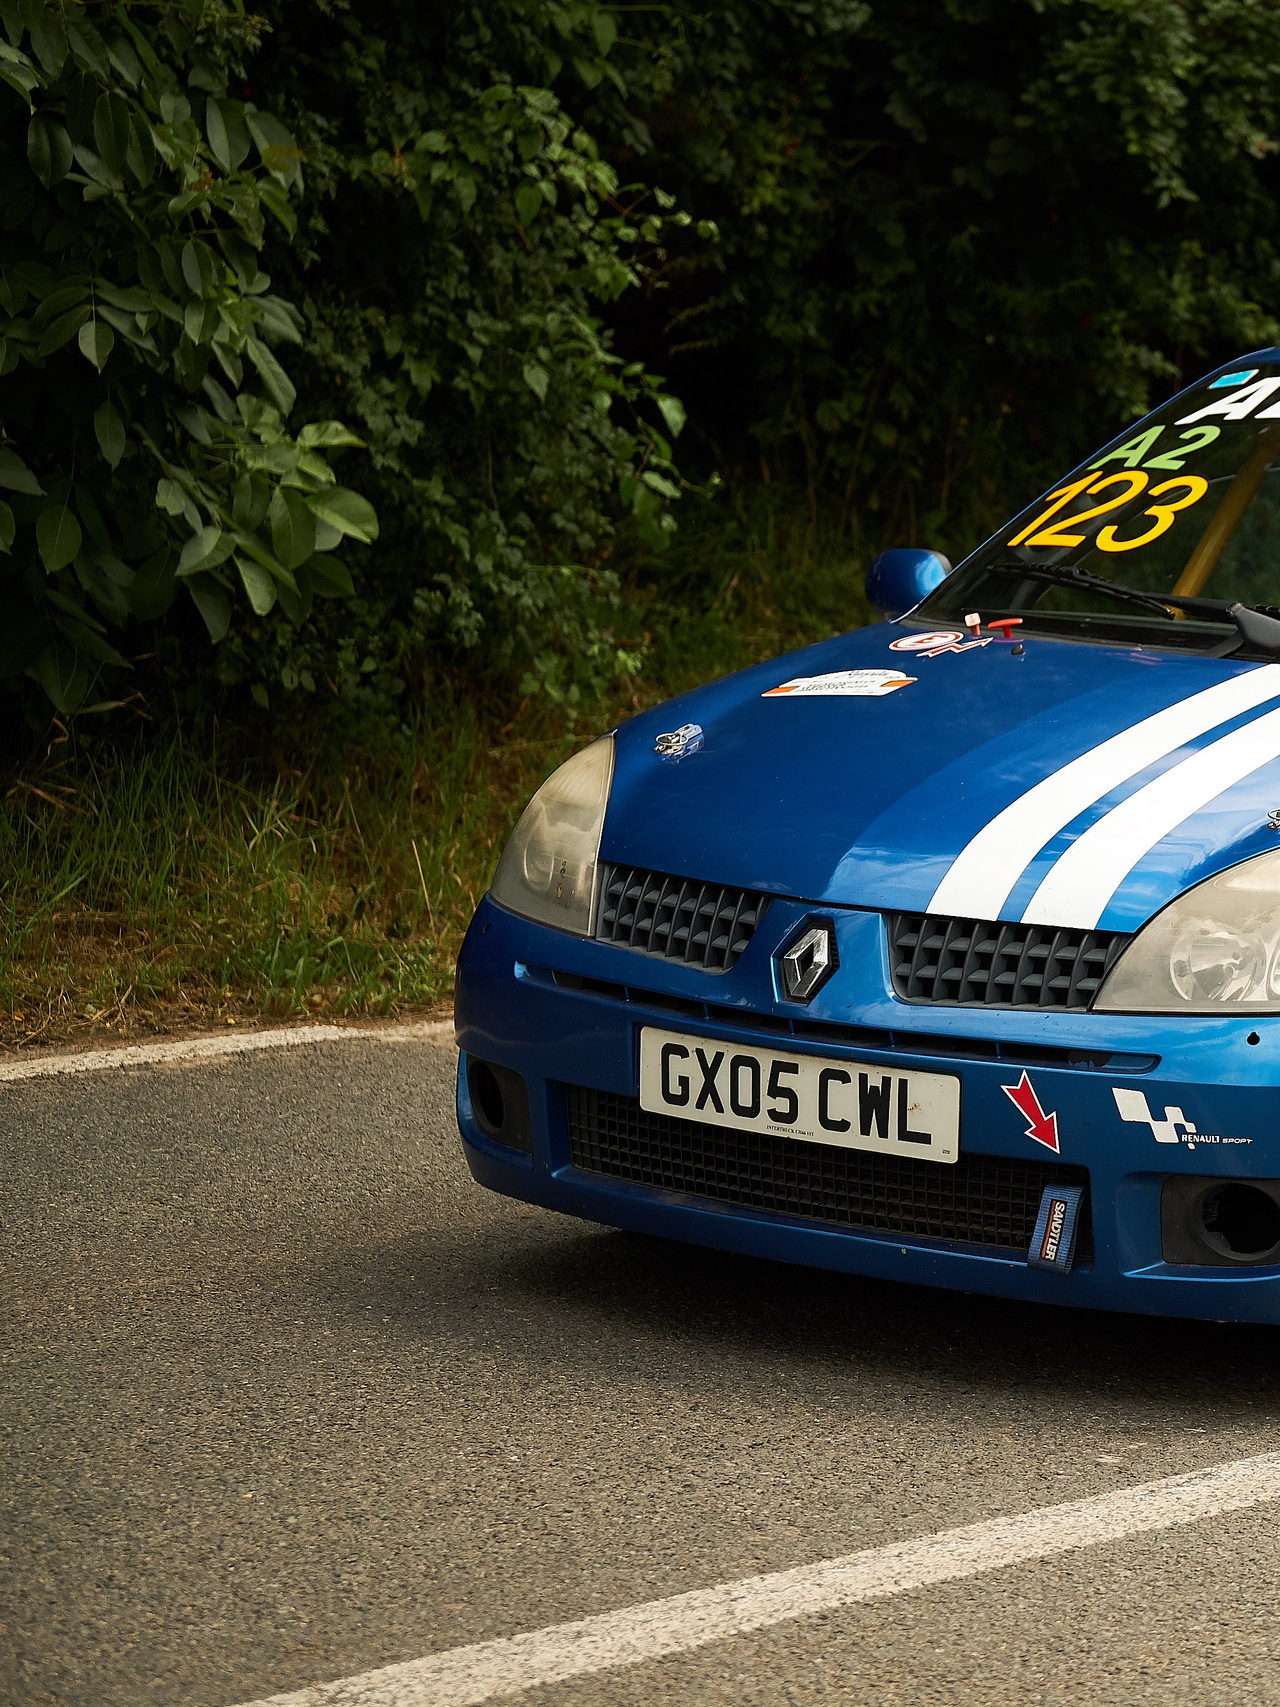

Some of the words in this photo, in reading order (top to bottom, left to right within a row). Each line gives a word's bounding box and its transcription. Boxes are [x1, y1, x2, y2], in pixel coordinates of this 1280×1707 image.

[1085, 424, 1221, 471] A2
[1007, 470, 1209, 552] 123
[660, 1042, 799, 1124] GX05
[818, 1067, 932, 1145] CWL
[766, 1125, 794, 1134] INTERTRUCK
[1181, 1133, 1220, 1143] RENAULT
[1046, 1200, 1066, 1262] SANDTLER
